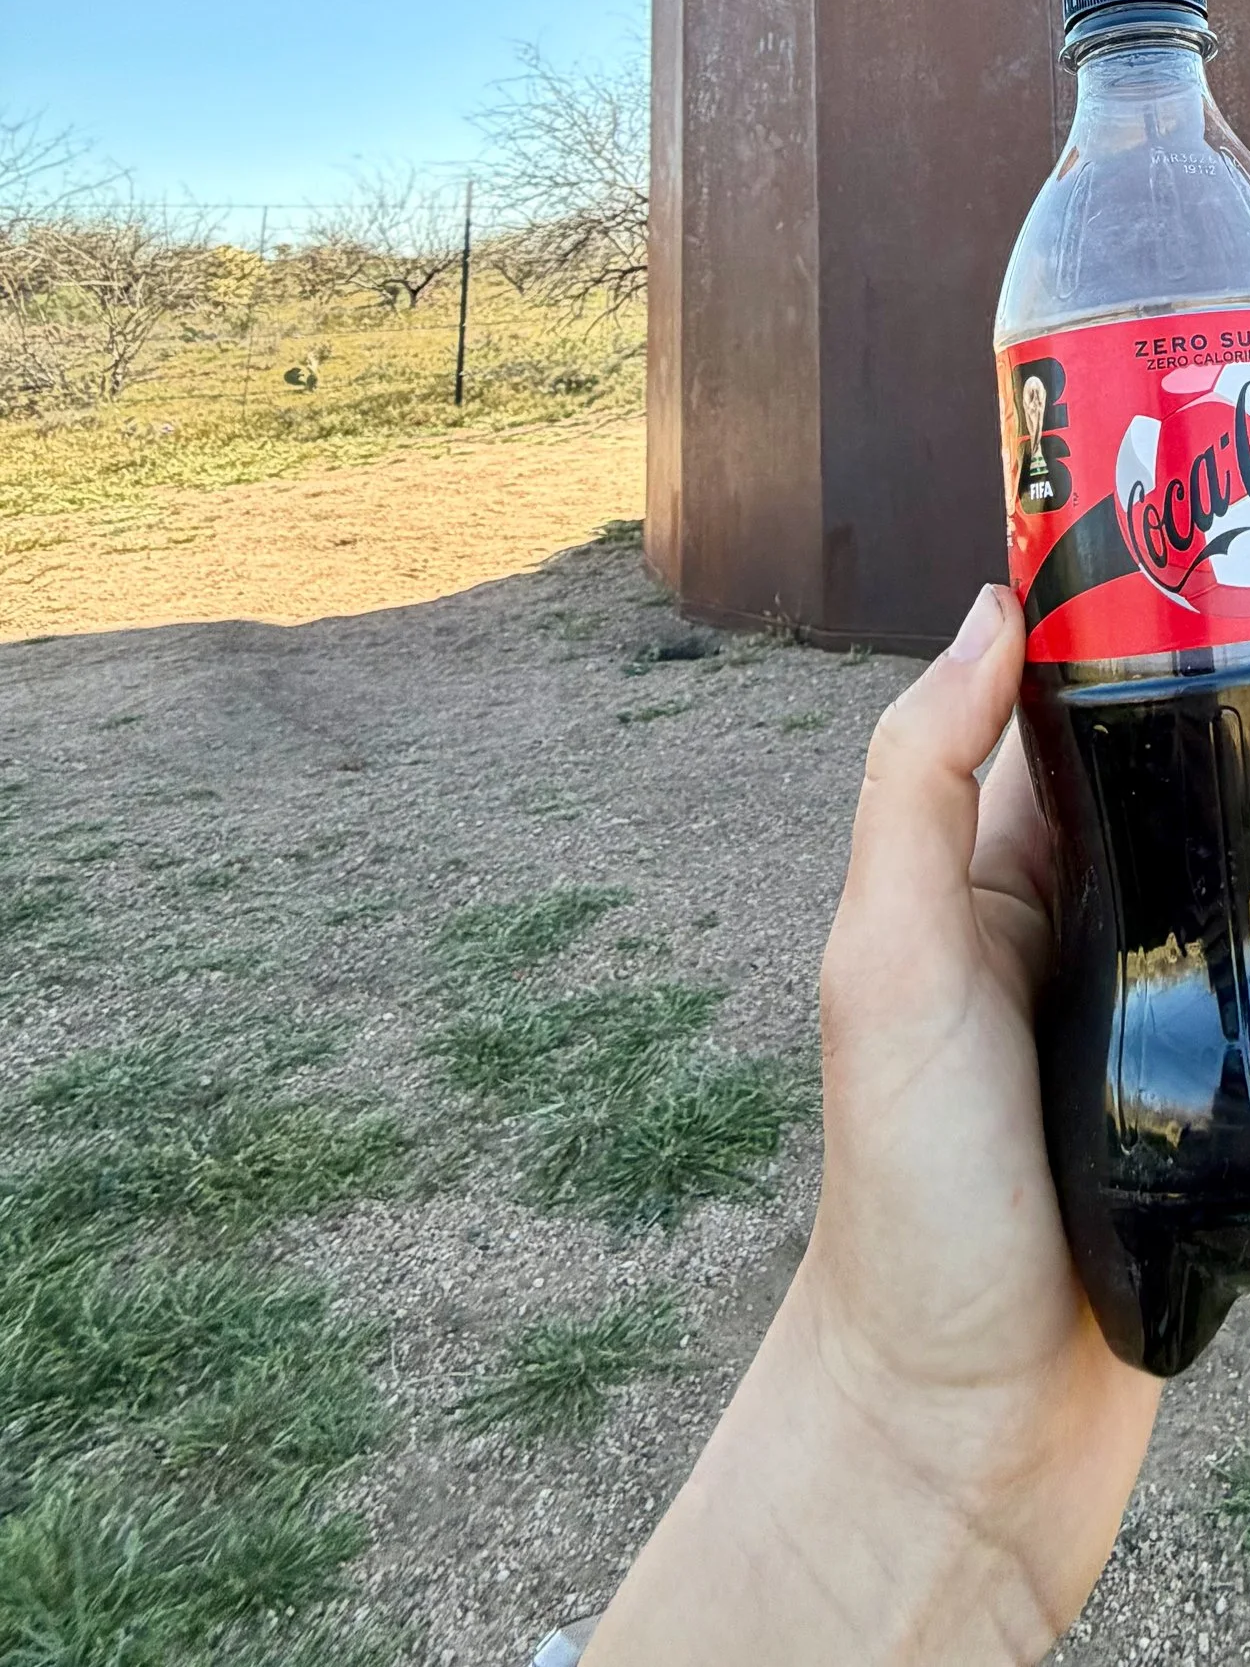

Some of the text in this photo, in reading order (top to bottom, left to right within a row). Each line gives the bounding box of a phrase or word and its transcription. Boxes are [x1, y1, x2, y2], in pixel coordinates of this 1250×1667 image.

[1135, 334, 1207, 358] ZERO
[1147, 355, 1188, 370] ZERO
[1030, 481, 1053, 500] FIFA
